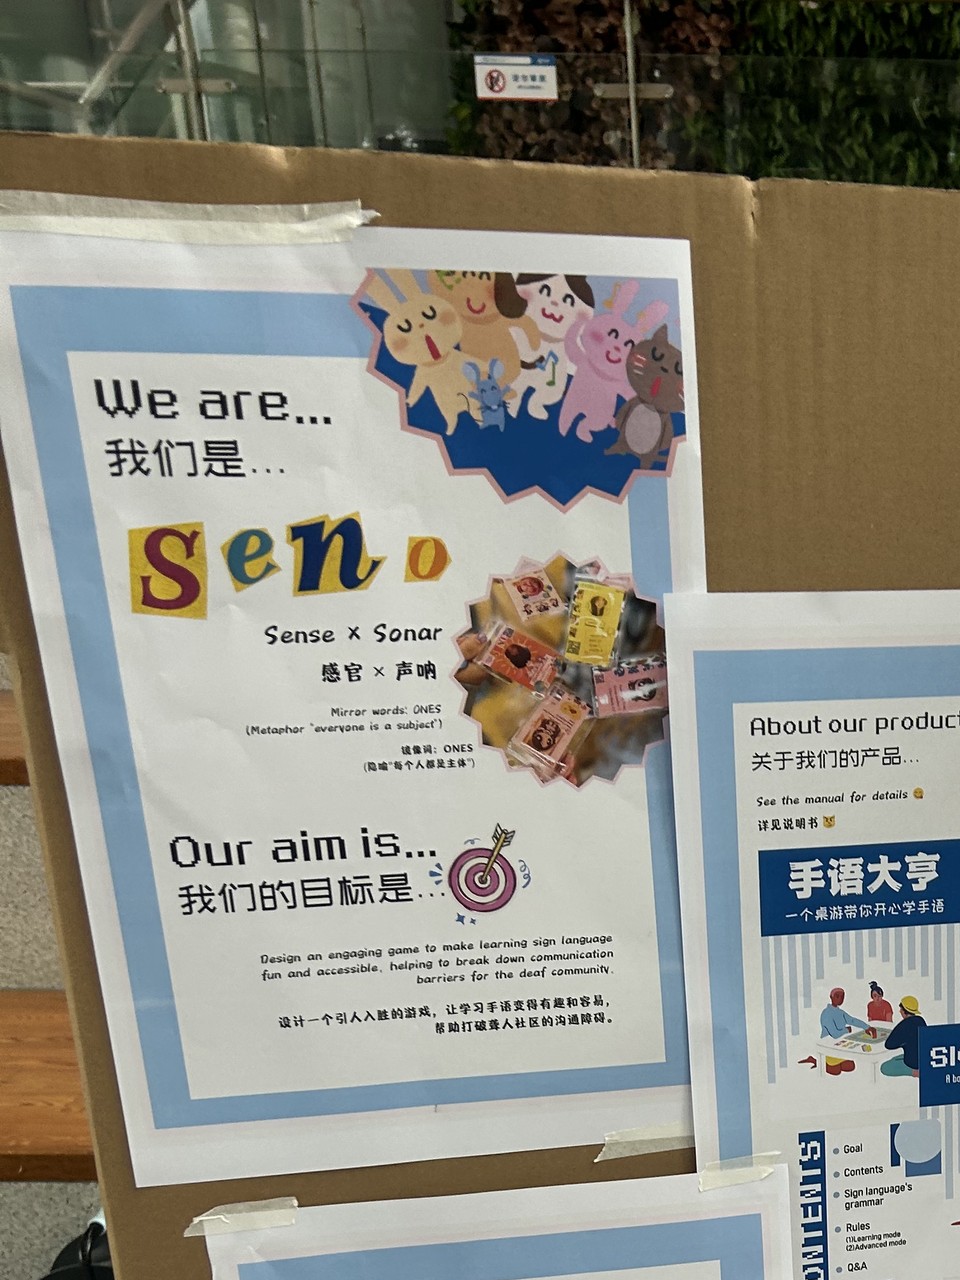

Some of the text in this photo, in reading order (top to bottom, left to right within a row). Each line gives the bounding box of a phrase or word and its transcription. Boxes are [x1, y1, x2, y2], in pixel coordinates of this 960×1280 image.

[94, 379, 332, 425] We are...
[264, 625, 336, 645] Sense
[373, 623, 443, 643] Sonar
[321, 662, 363, 683] 感官
[395, 660, 437, 682] 声呐
[330, 704, 442, 717] Mirror words: ONES
[245, 725, 305, 736] (Metaphor
[369, 721, 379, 731] is
[750, 715, 822, 737] About
[828, 718, 868, 733] our
[443, 743, 474, 754] ONES
[756, 789, 908, 807] See the manual for details
[757, 816, 818, 832] 详见说明书
[169, 827, 437, 868] Our aim is...
[788, 851, 941, 899] 手语大亨
[785, 898, 945, 922] 一个桌游带你开心学手语
[945, 1074, 951, 1084] A
[843, 1143, 863, 1154] Goal
[843, 1165, 884, 1178] Contents
[844, 1182, 913, 1200] Sign language's
[844, 1198, 884, 1211] grammar
[846, 1221, 871, 1233] Rules
[882, 1230, 901, 1239] mode
[888, 1238, 907, 1247] mode
[847, 1261, 868, 1273] Q&A
